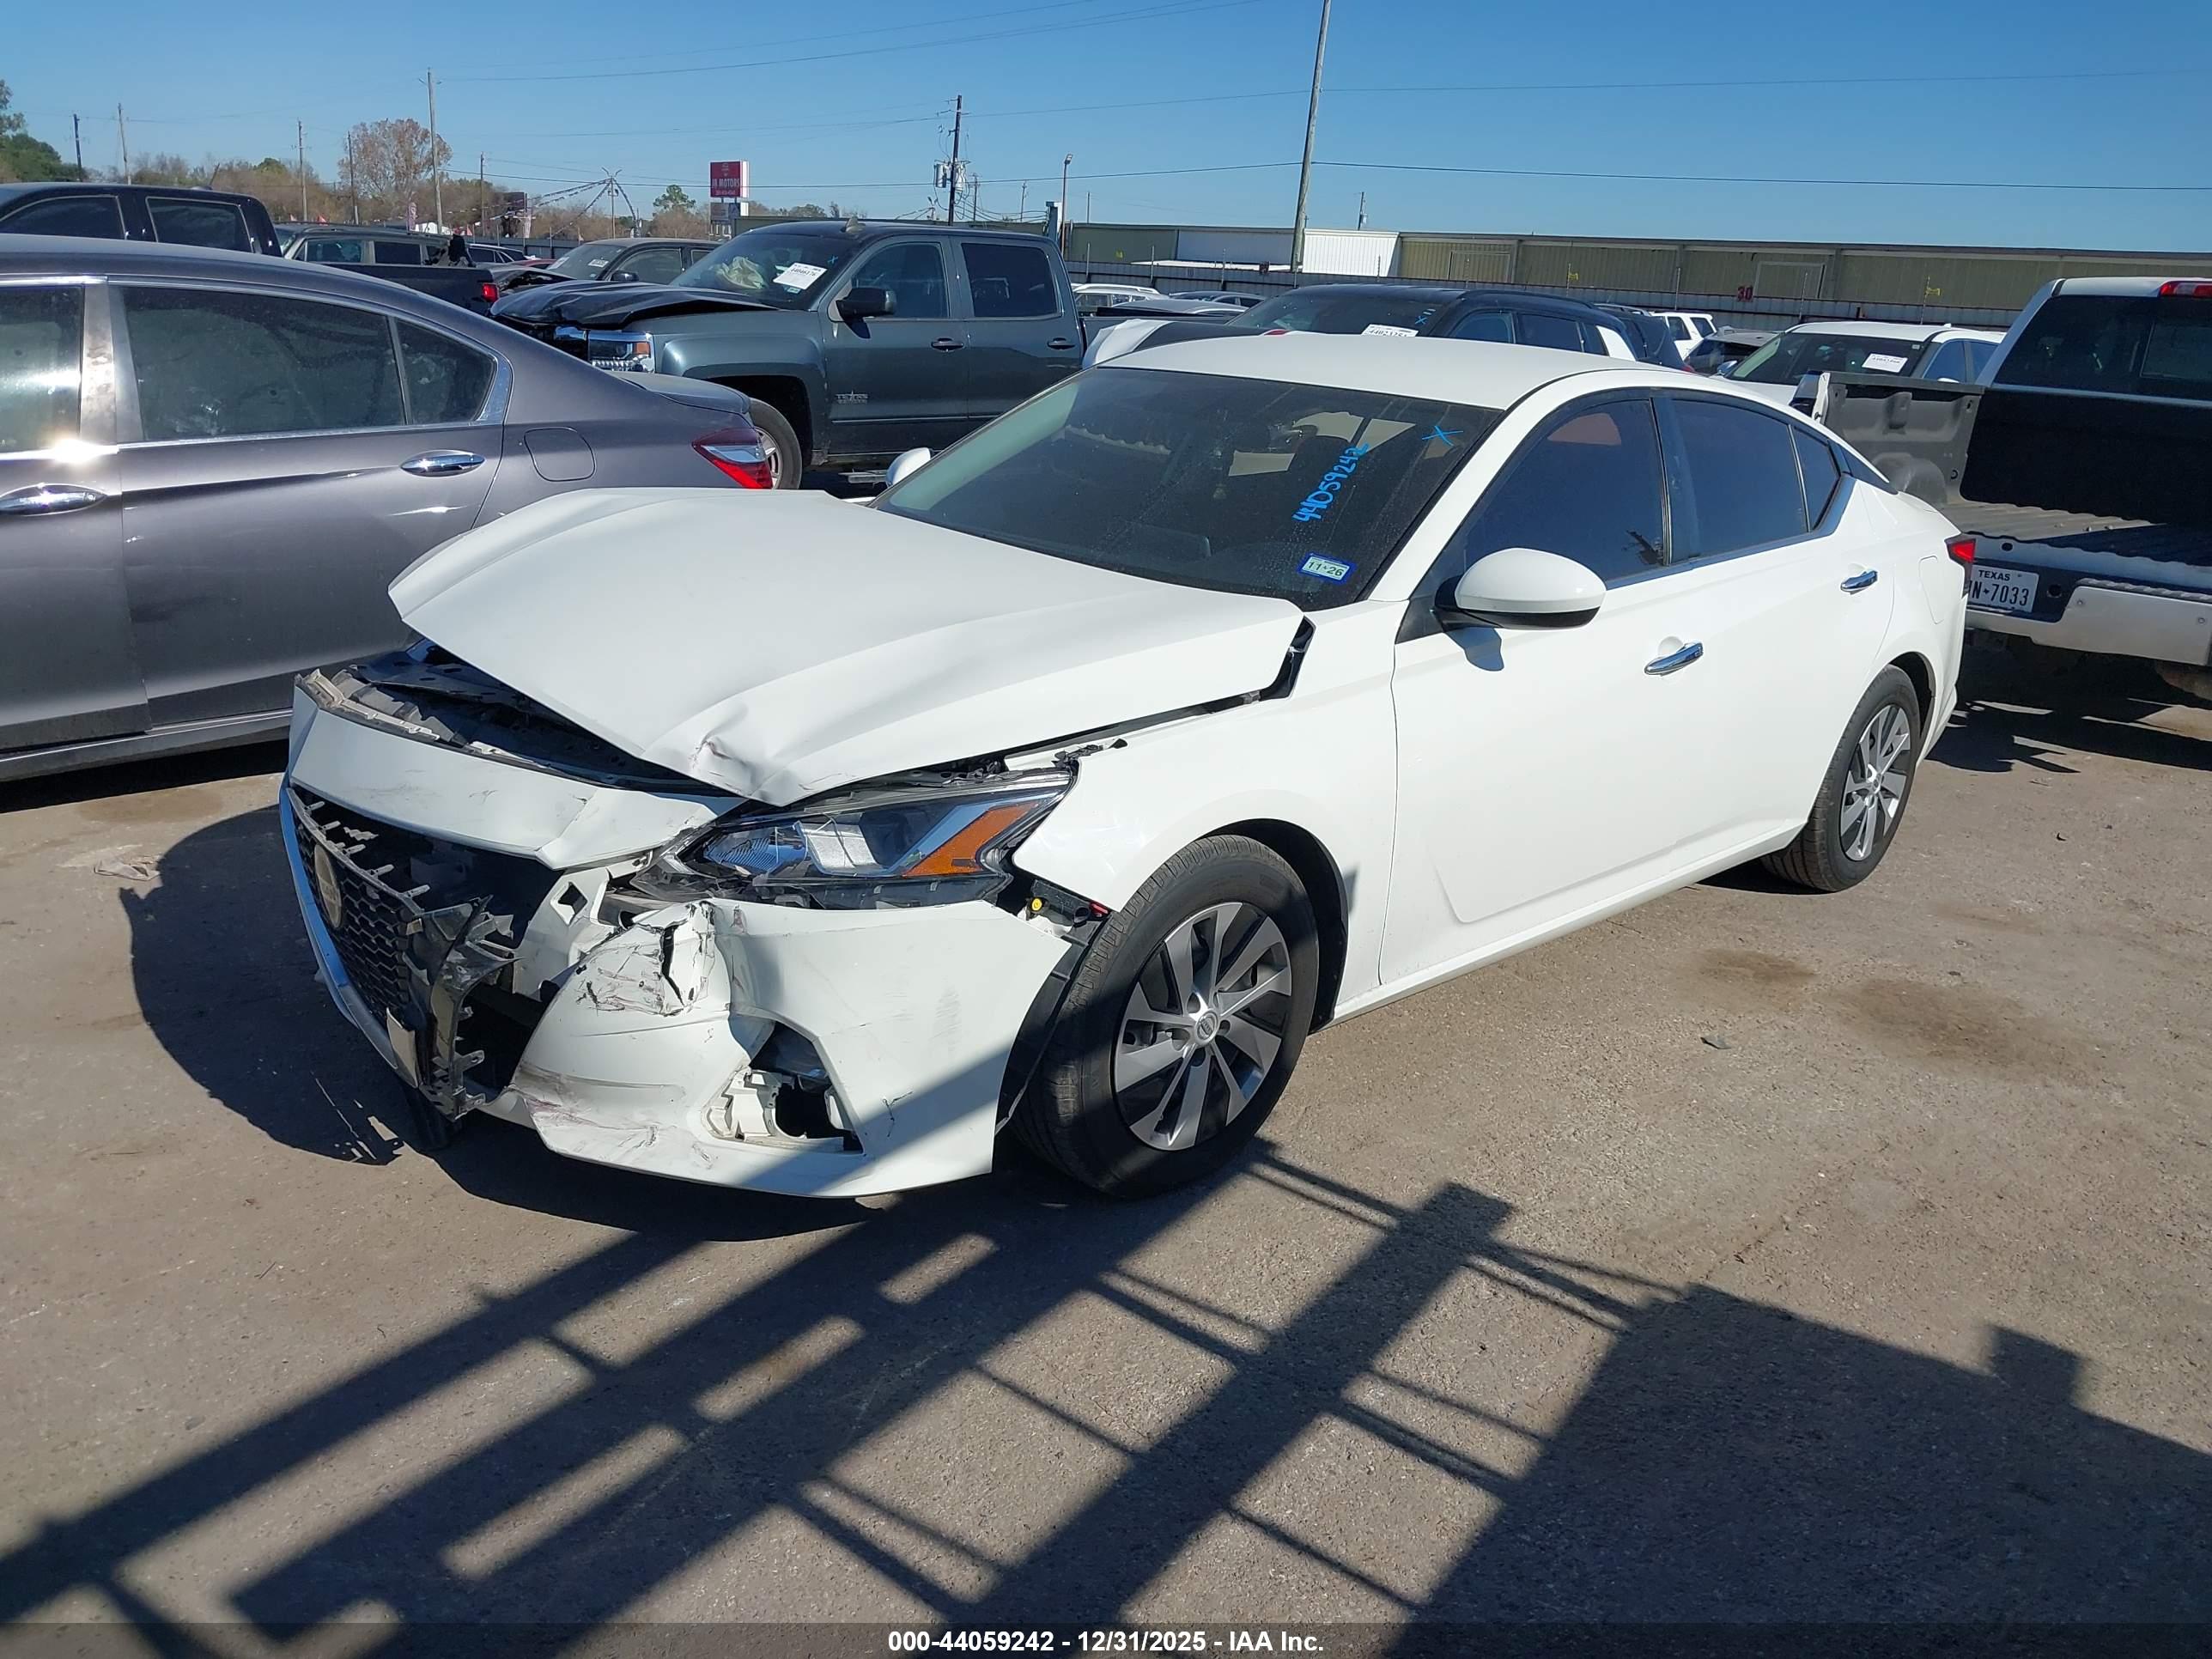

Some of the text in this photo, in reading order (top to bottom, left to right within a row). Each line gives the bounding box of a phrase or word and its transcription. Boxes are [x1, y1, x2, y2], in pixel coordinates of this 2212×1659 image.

[719, 178, 740, 187] MOTORS
[1291, 443, 1370, 522] 44059242
[1978, 569, 2011, 581] TEXAS
